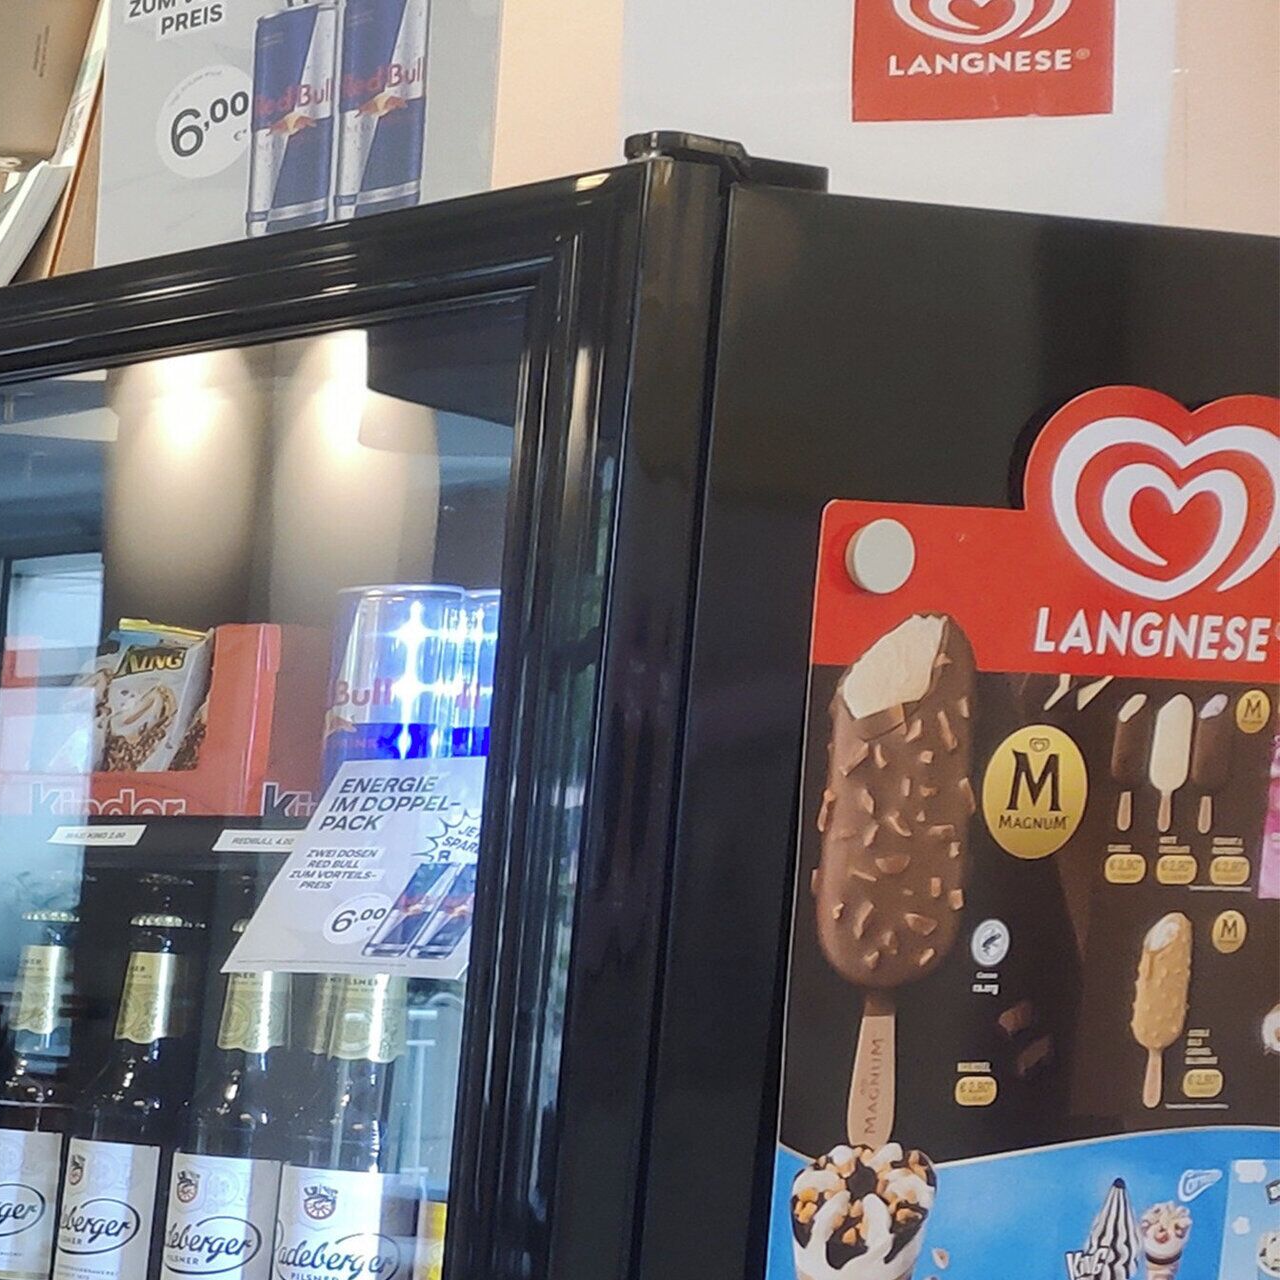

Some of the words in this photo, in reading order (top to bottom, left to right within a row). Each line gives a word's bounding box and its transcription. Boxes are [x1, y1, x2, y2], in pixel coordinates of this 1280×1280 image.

[161, 4, 223, 35] PREIS
[888, 49, 1073, 77] LANGNESE
[171, 91, 249, 157] 6,00
[1034, 606, 1272, 662] LANGNESE
[340, 776, 439, 794] ENERGIE
[1006, 750, 1061, 812] M
[329, 797, 358, 813] IM
[359, 795, 461, 812] DOPPEL-
[319, 814, 384, 831] PACK
[998, 815, 1069, 831] MAGNUM
[307, 860, 331, 869] RED
[332, 860, 360, 869] BULL
[289, 870, 316, 879] ZUM
[317, 871, 378, 880] VORTEILS-
[299, 881, 333, 889] PREIS
